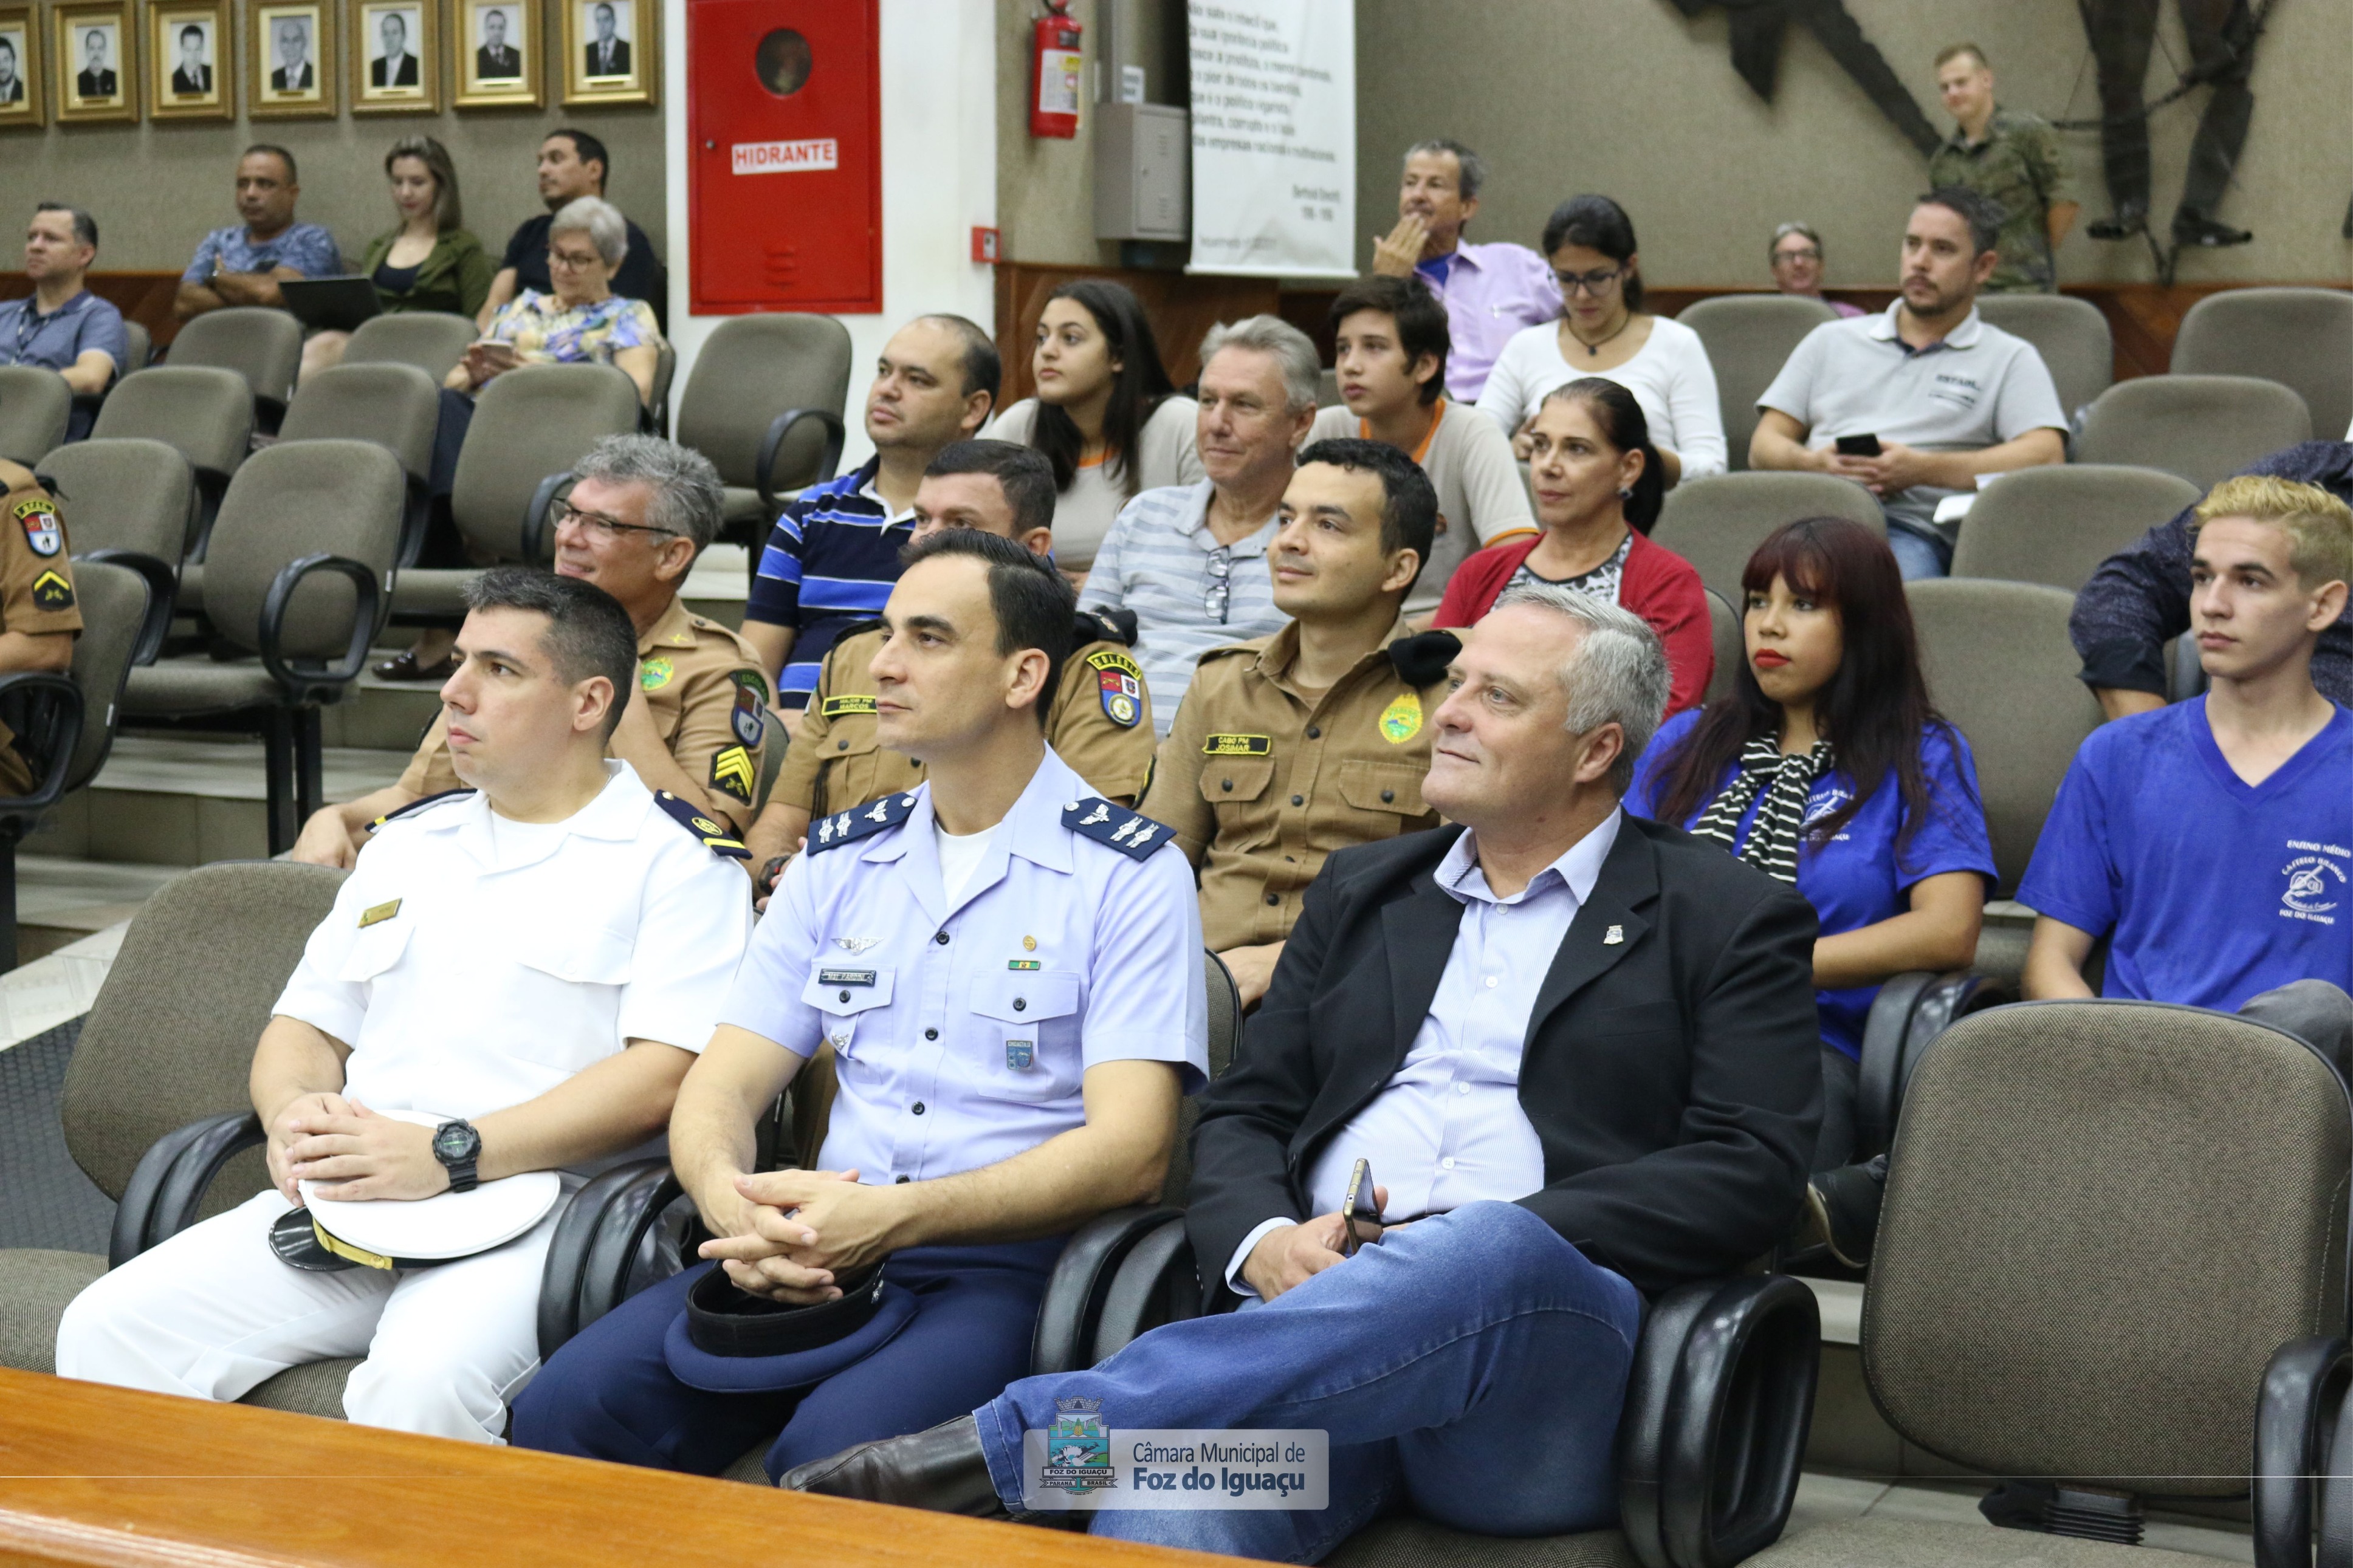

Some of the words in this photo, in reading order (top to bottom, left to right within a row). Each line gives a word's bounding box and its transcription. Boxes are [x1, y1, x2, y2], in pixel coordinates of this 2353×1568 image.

[735, 143, 833, 166] HIDRANTE
[2286, 839, 2321, 852] ENSINO
[2322, 844, 2352, 858] MÉDIO
[2281, 856, 2316, 875] CASTELO
[2317, 857, 2347, 883] BRANCO
[2279, 909, 2293, 918] FOZ
[2294, 911, 2307, 920] DO
[2307, 913, 2335, 925] IGUAÇU
